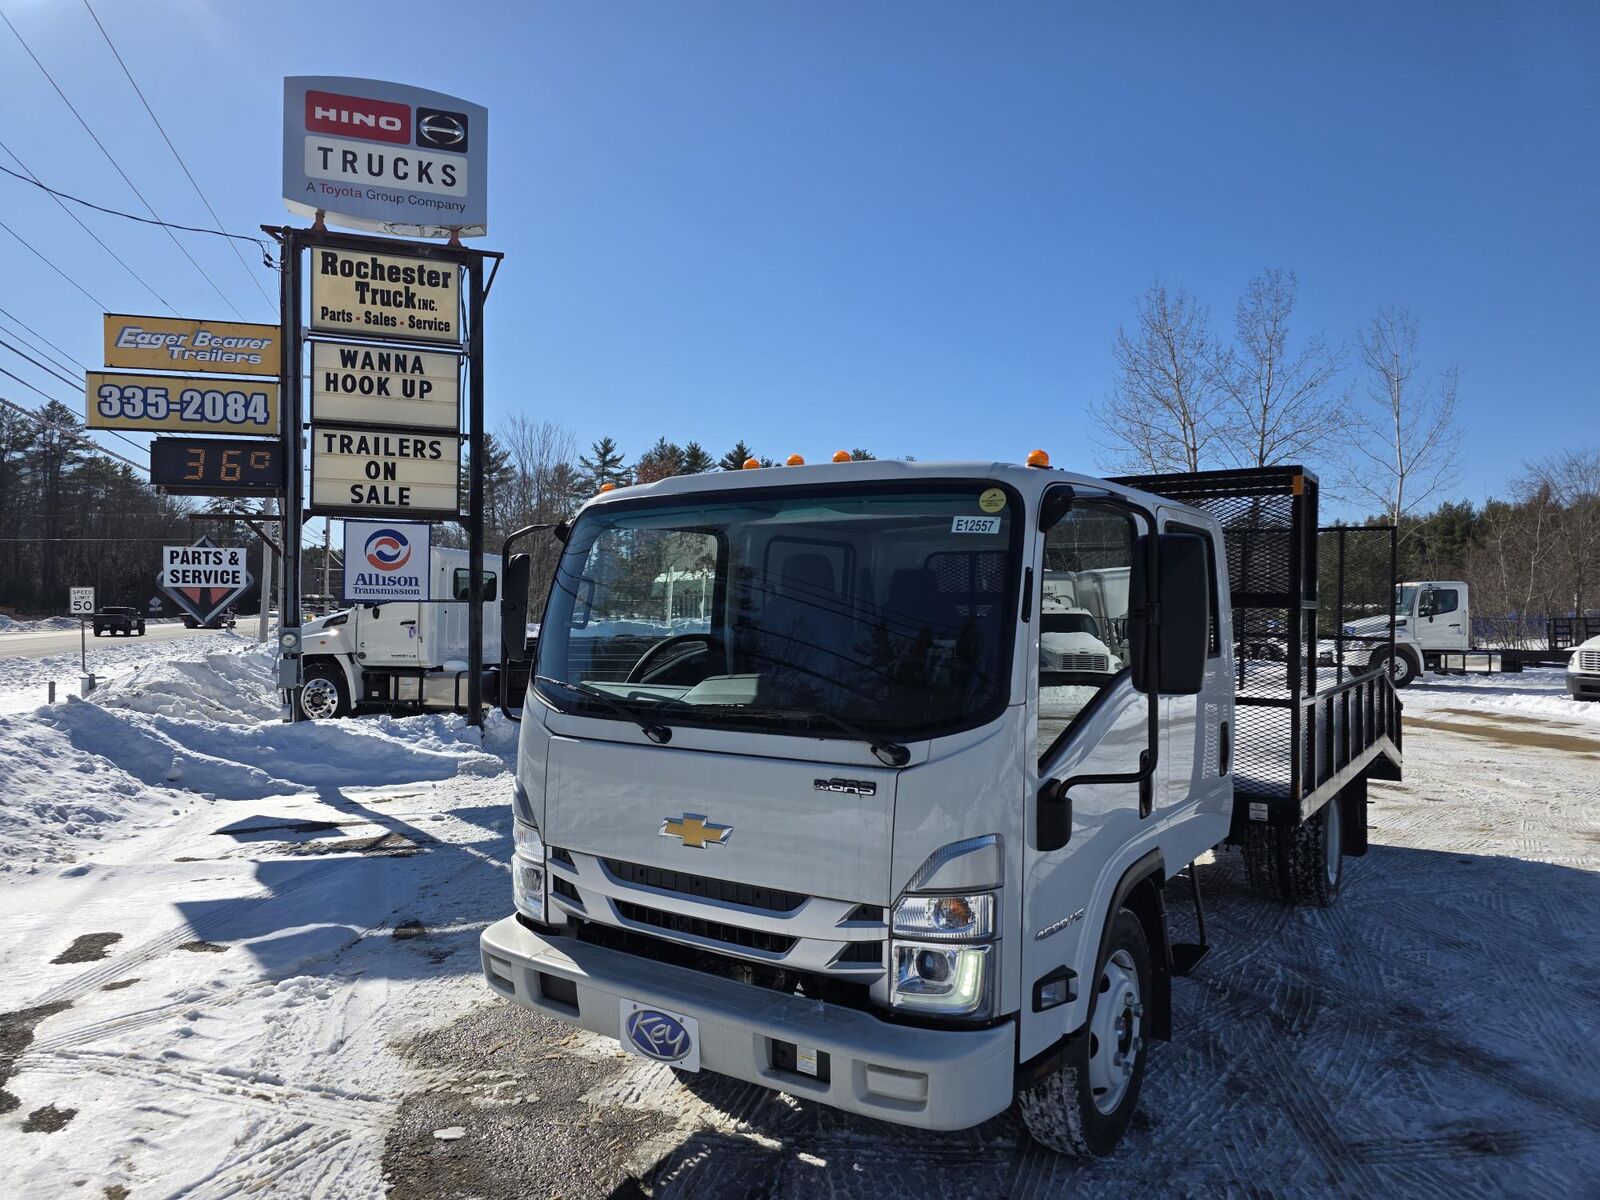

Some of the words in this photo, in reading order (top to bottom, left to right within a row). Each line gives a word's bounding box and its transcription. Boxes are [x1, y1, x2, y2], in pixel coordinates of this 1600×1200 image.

[314, 106, 402, 131] HINO
[317, 146, 457, 187] TRUCKS
[306, 182, 316, 192] A
[320, 183, 362, 199] Toyota
[366, 189, 404, 205] Group
[408, 195, 466, 213] Company
[321, 251, 452, 288] Rochester
[355, 281, 416, 309] Truck
[418, 298, 438, 311] INC.
[321, 306, 353, 322] Parts
[364, 310, 397, 327] Sales
[408, 315, 451, 332] Service
[116, 326, 189, 349] Eager
[193, 330, 273, 350] Beaver
[168, 345, 263, 364] Trailers
[339, 349, 425, 375] WANNA
[325, 372, 391, 396] HOOK
[402, 379, 433, 399] UP
[97, 384, 270, 425] 335-2084
[323, 433, 442, 460] TRAILERS
[365, 460, 397, 481] ON
[350, 484, 411, 506] SALE
[955, 519, 995, 532] E12557
[169, 550, 223, 566] PARTS
[228, 551, 240, 566] &
[169, 569, 241, 585] SERVICE
[353, 573, 420, 587] Allison
[353, 586, 420, 595] Transmission
[73, 600, 92, 611] 50
[631, 1011, 686, 1059] Key
